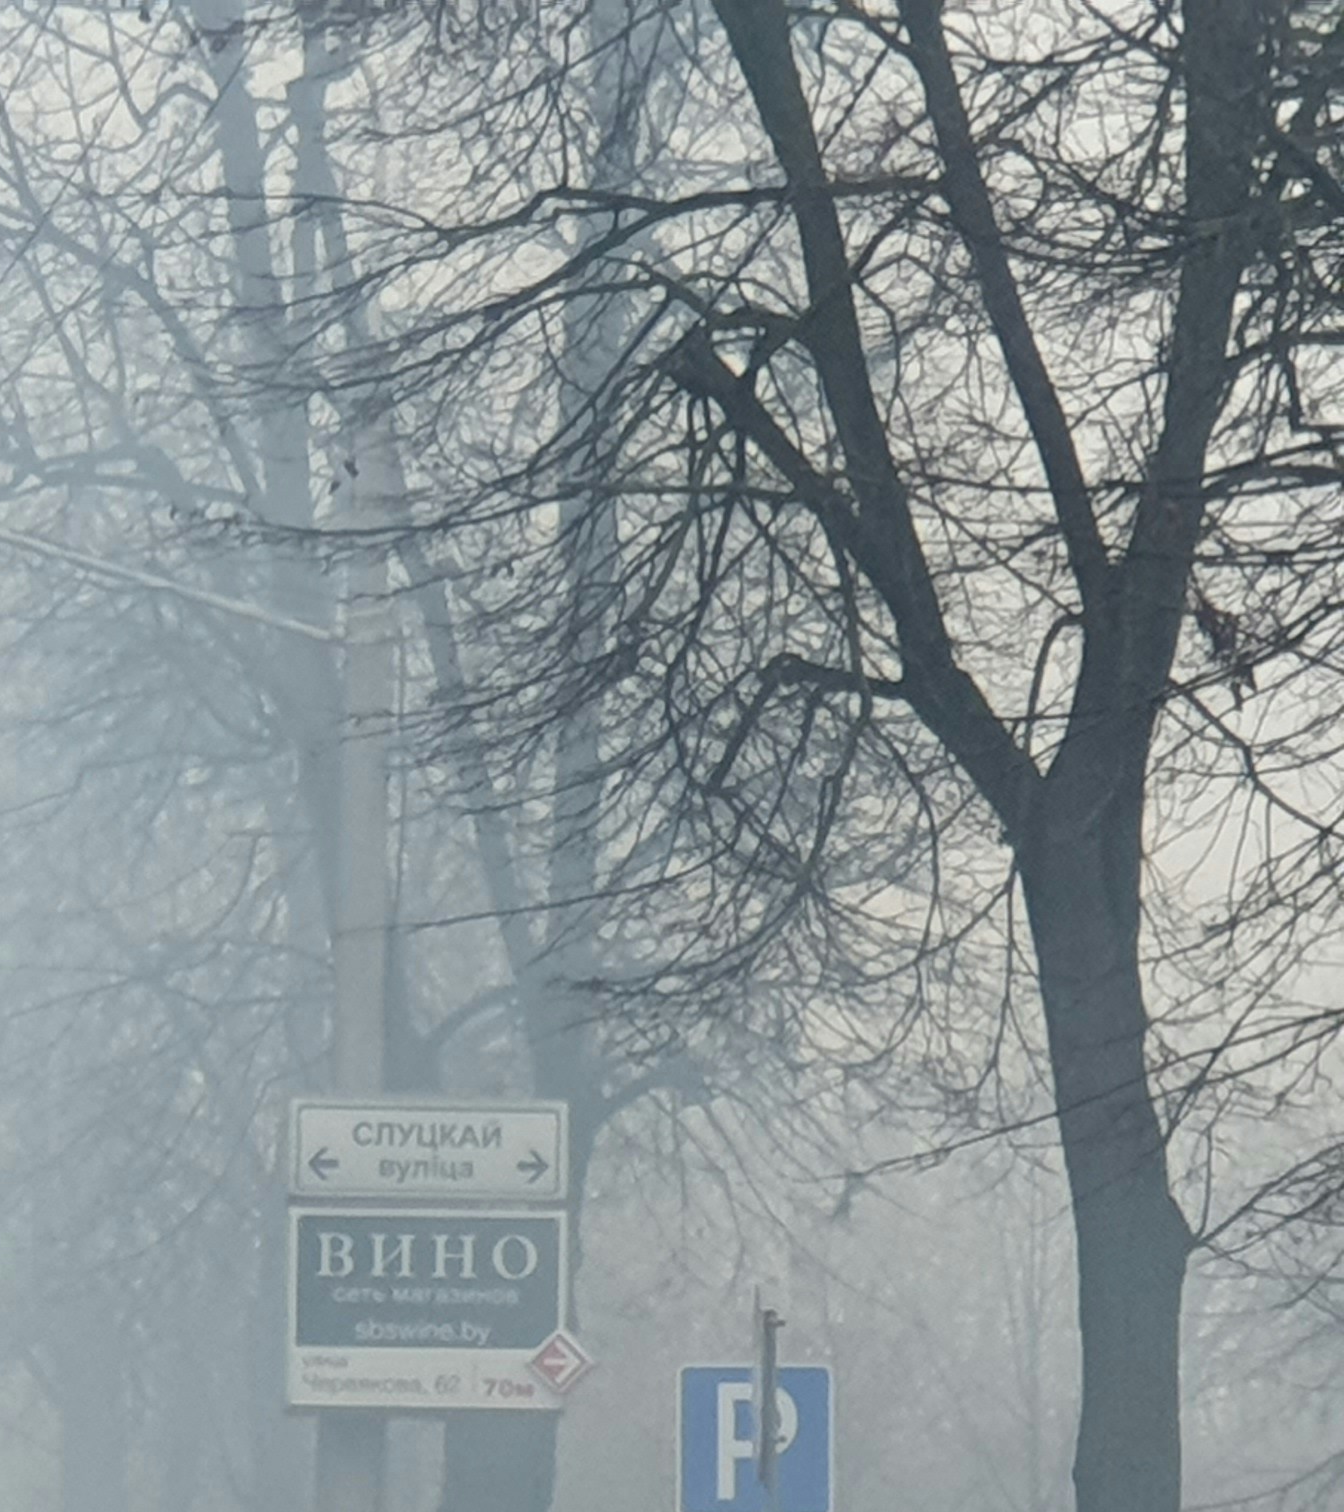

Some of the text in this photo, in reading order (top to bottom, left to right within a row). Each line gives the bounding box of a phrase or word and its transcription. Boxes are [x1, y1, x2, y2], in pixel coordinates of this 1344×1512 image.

[352, 1119, 502, 1150] СЛУЦКАЙ
[378, 1154, 474, 1183] вуліца
[316, 1231, 539, 1280] ВИНО
[716, 1381, 799, 1501] P
